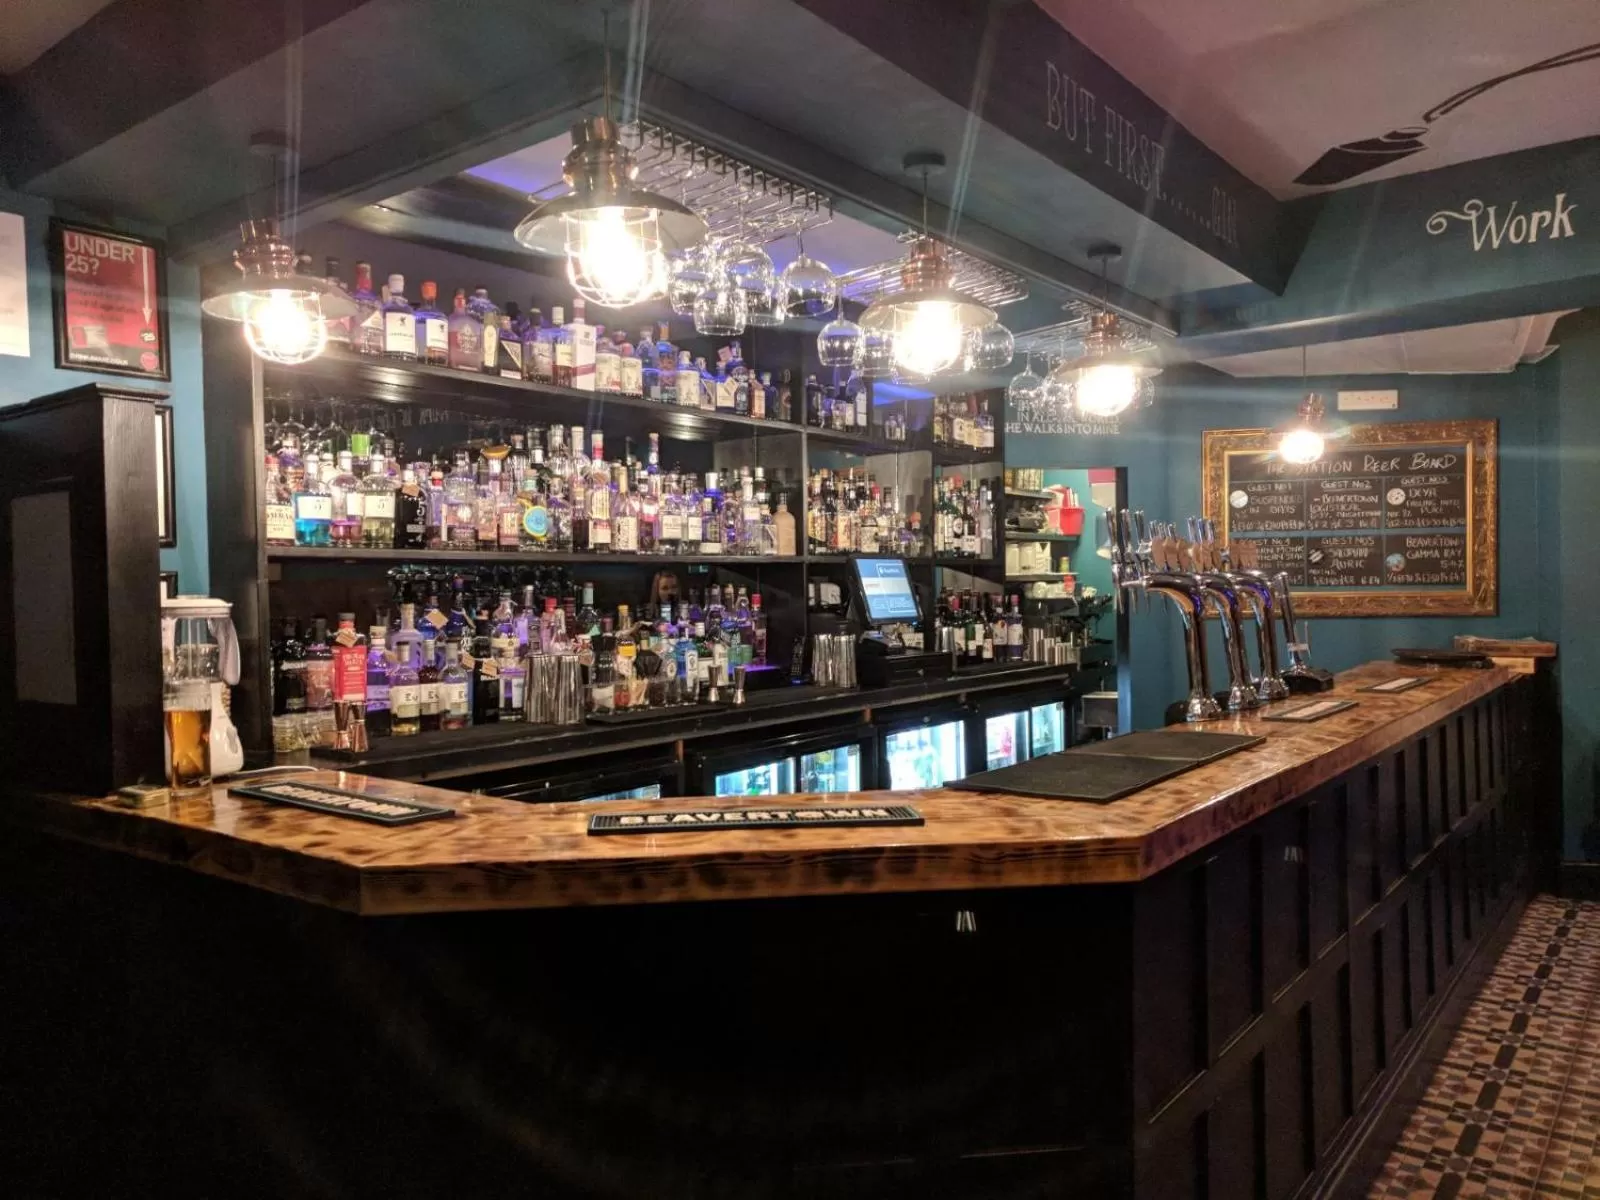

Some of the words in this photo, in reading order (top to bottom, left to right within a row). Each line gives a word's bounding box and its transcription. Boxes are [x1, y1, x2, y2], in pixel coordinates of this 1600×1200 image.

[1046, 61, 1096, 154] BUT
[1426, 192, 1579, 251] Work
[65, 233, 135, 264] UNDER
[65, 254, 101, 276] 25?
[1408, 452, 1457, 470] BOARD
[620, 807, 889, 825] BEAVERTOWN
